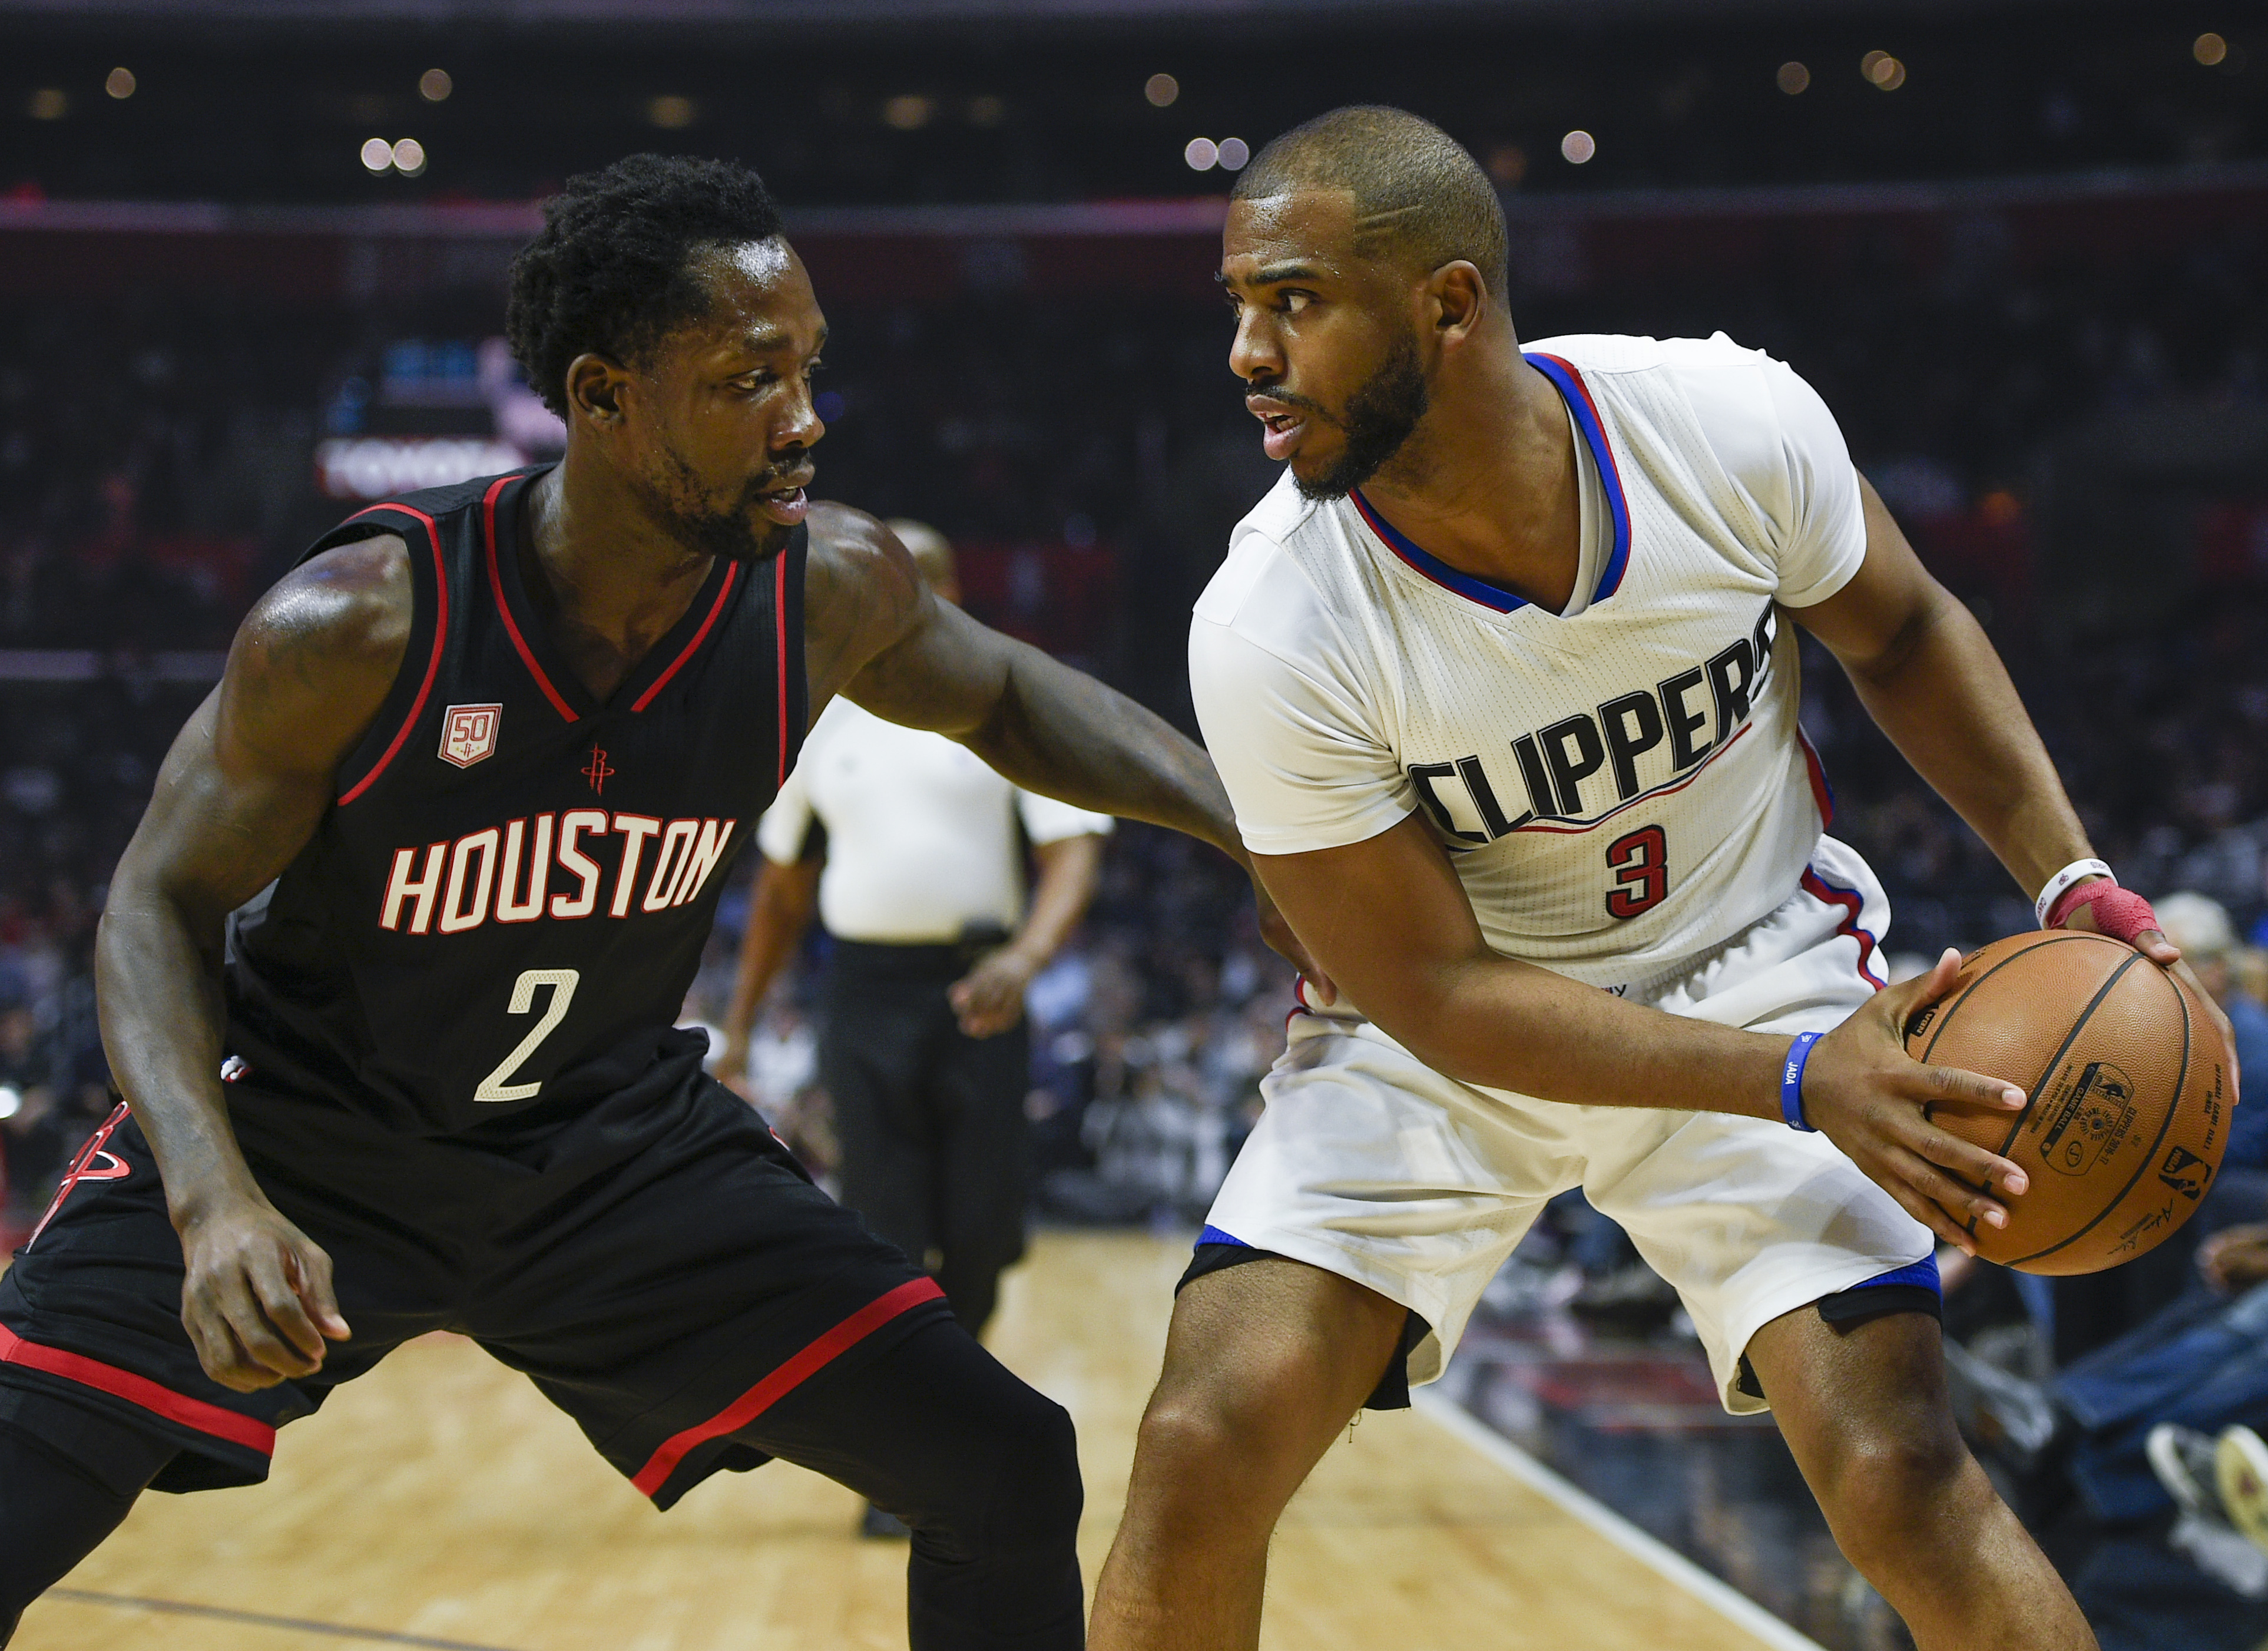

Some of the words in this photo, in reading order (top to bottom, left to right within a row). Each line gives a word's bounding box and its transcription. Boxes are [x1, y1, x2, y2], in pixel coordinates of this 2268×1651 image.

[453, 715, 489, 742] 50
[1406, 594, 1777, 843] CLIPPERS
[378, 807, 737, 935] HOUSTON
[1605, 824, 1668, 919] 3
[473, 968, 580, 1102] 2
[1915, 1013, 1933, 1034] NBA
[1785, 1062, 1798, 1085] JADA
[2067, 1086, 2084, 1110] GAME
[2054, 1109, 2071, 1131] BALL
[2113, 1106, 2137, 1139] CLIPPERS
[2211, 1103, 2220, 1126] GAME
[2098, 1137, 2120, 1165] 2016-17
[2204, 1129, 2215, 1150] BALL
[2165, 1149, 2183, 1172] NBA
